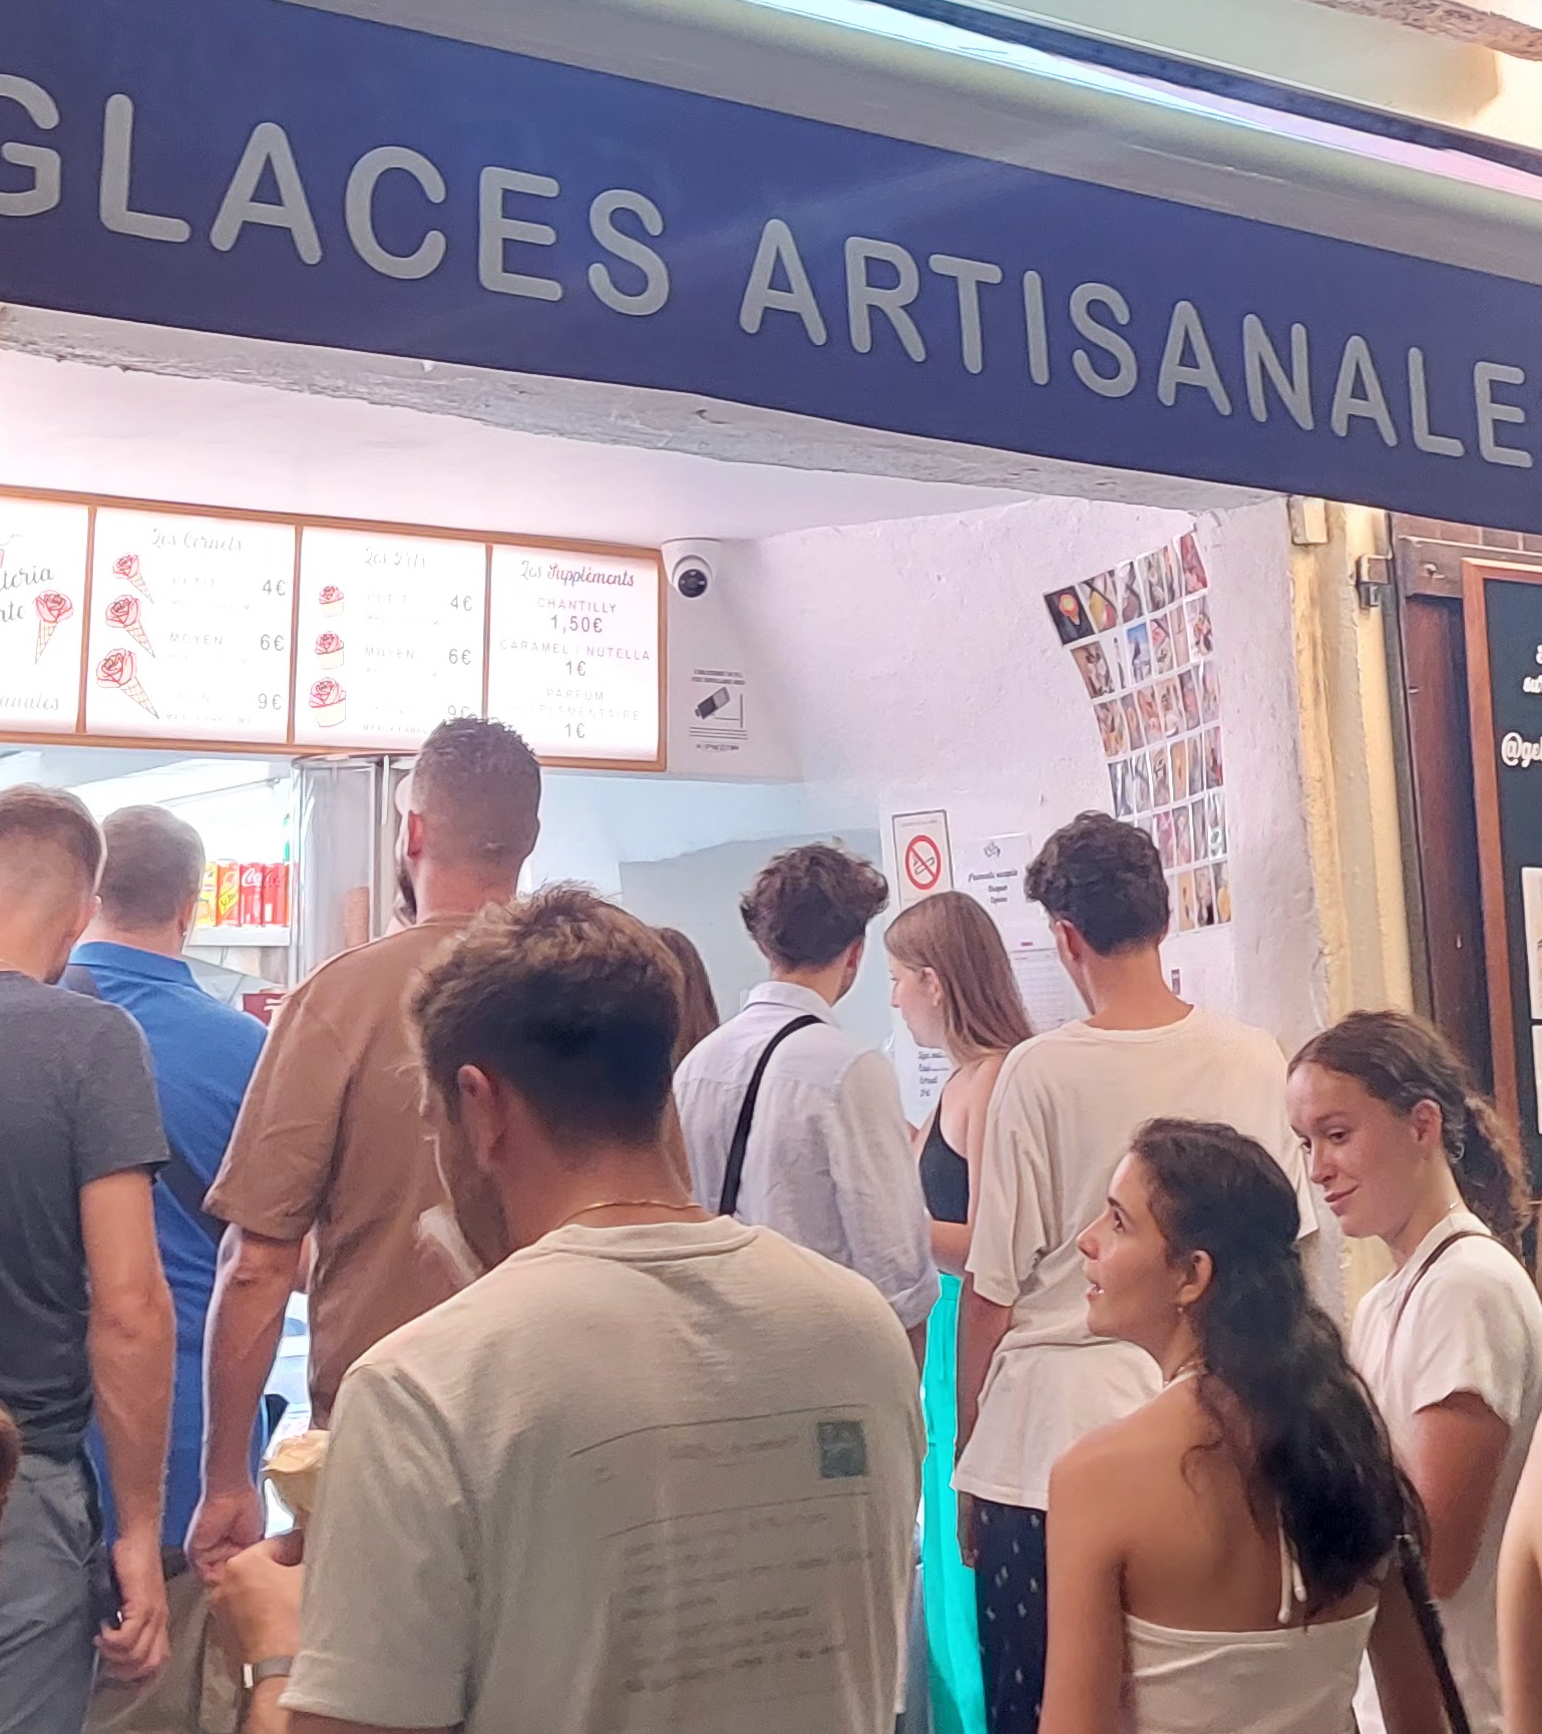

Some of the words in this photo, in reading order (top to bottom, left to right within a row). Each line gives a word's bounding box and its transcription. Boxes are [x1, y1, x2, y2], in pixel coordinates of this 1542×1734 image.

[547, 564, 635, 588] Suppléments
[261, 578, 286, 596] 4€
[449, 595, 473, 612] 4€
[537, 597, 617, 614] CHANTILLY
[550, 613, 603, 634] 1,50€
[259, 634, 285, 652] 6€
[499, 639, 569, 655] CARAMEL
[586, 643, 651, 662] NUTELLA
[448, 648, 471, 666] 6€
[565, 661, 587, 677] 1€
[258, 693, 282, 710] 9€
[564, 723, 586, 739] 1€
